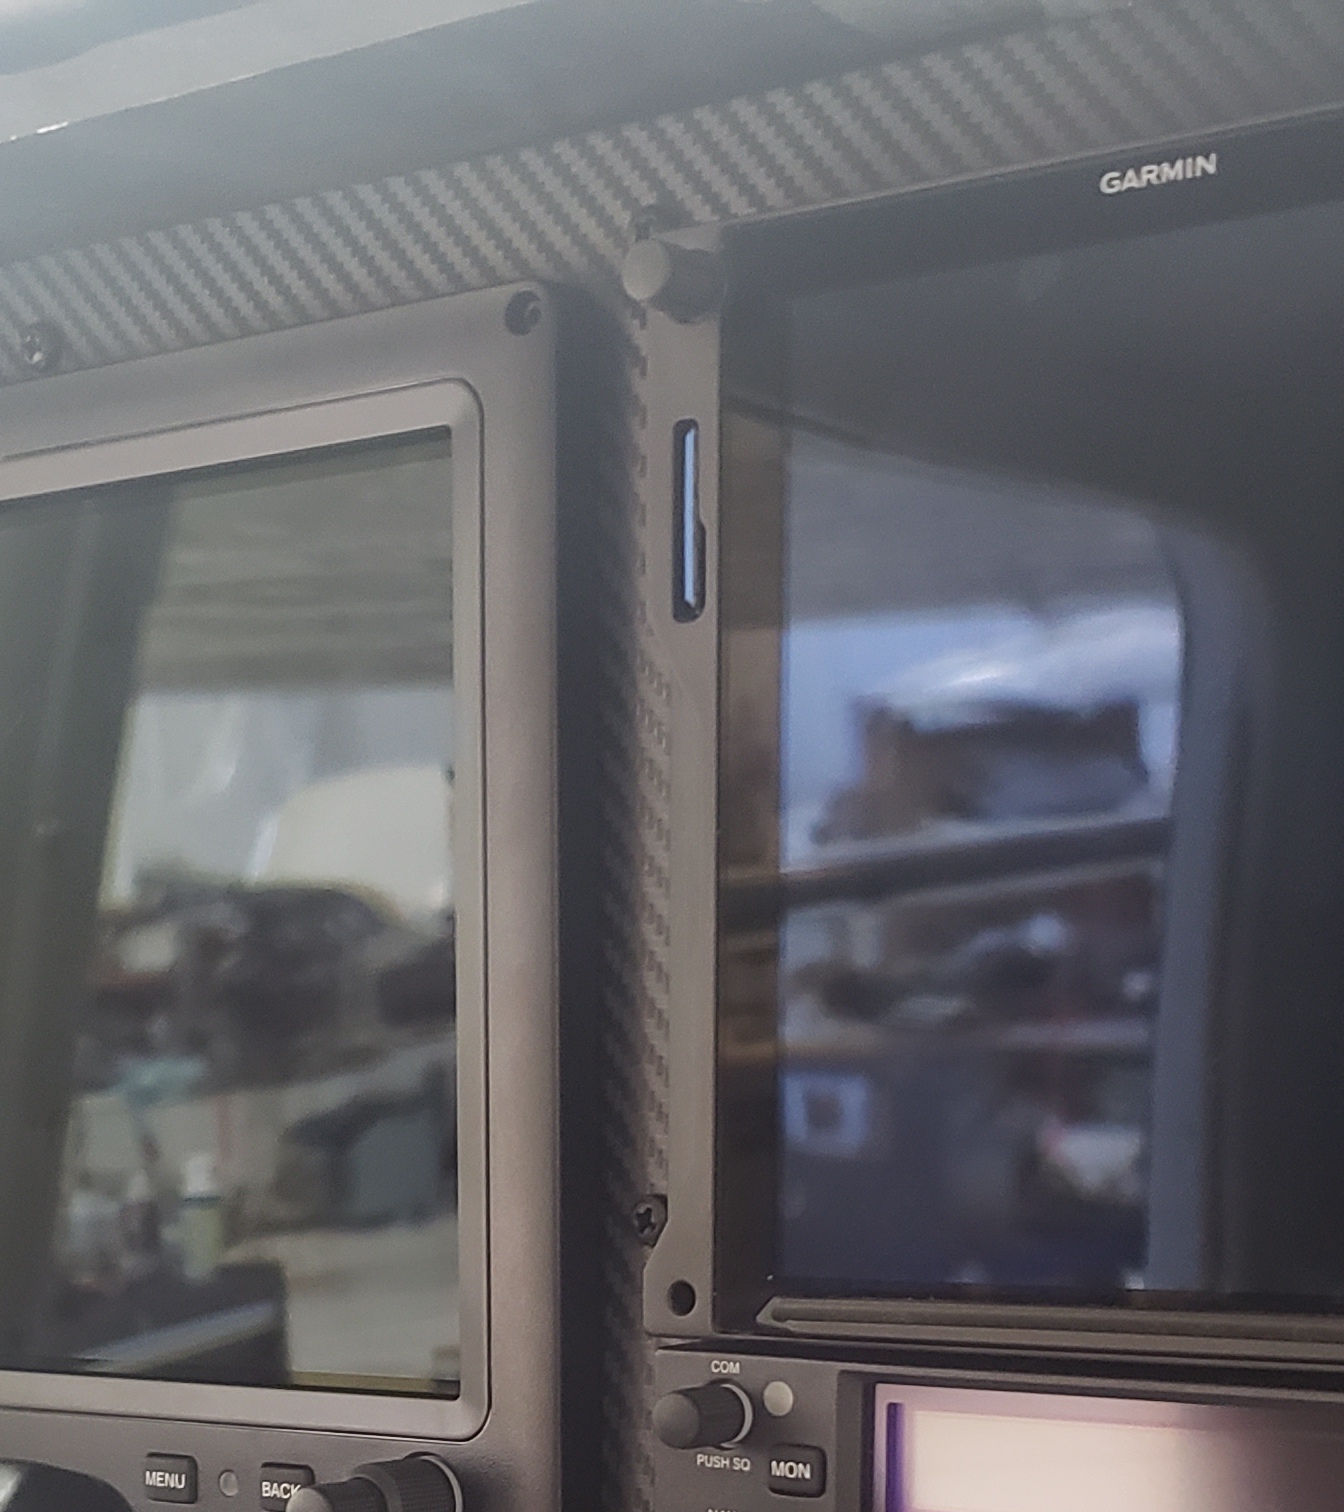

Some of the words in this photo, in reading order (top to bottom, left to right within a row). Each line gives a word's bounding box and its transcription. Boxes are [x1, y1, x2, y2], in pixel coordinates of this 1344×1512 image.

[1099, 152, 1218, 195] GARMIN
[711, 1360, 741, 1375] COM
[696, 1454, 730, 1470] PUSH
[732, 1457, 751, 1472] SQ
[771, 1460, 811, 1480] MON
[145, 1470, 186, 1489] MENU
